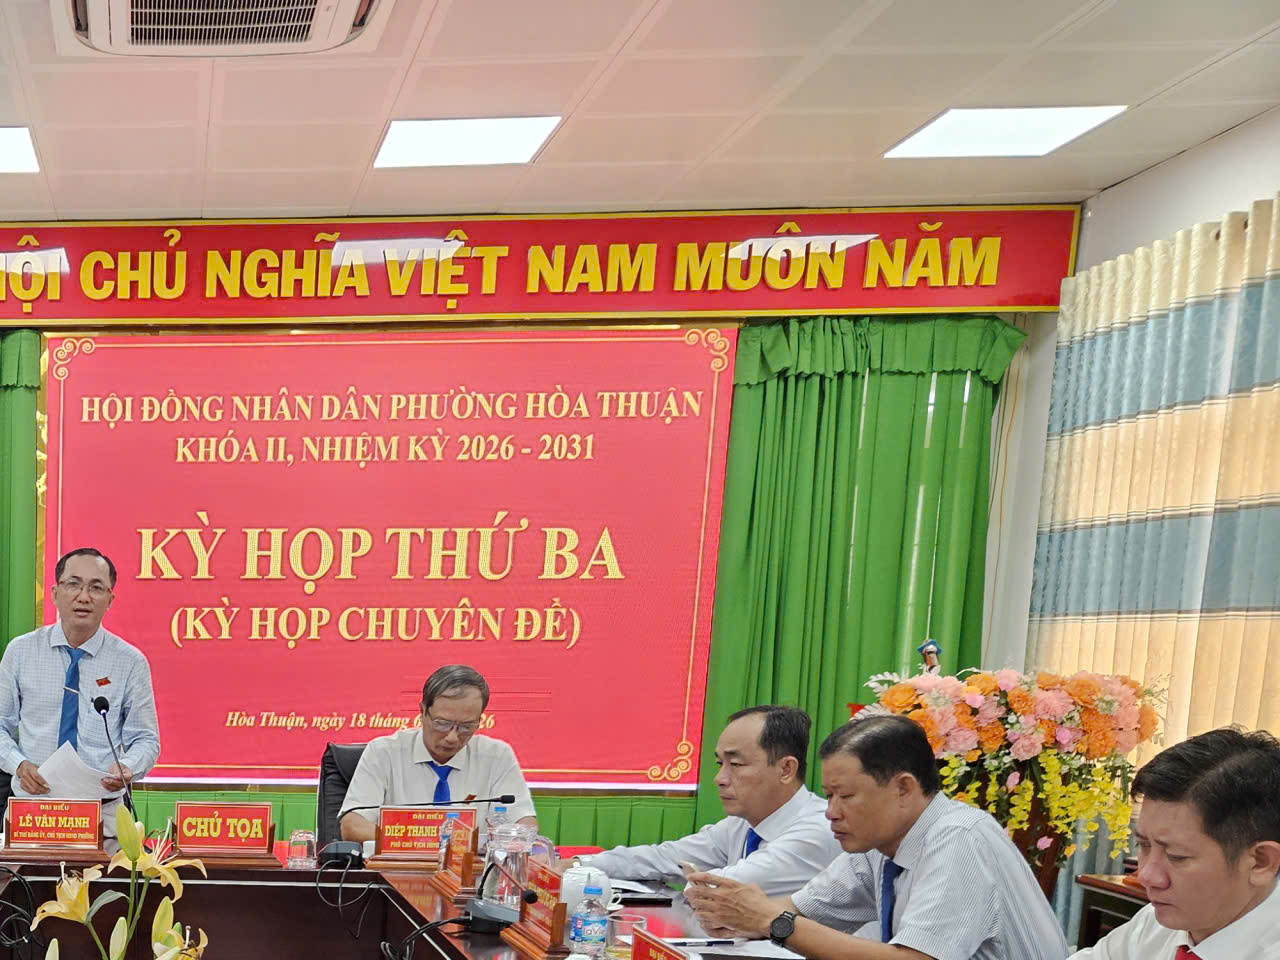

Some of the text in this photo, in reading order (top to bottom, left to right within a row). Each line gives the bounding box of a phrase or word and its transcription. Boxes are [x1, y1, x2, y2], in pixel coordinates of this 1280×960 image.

[80, 229, 187, 300] CHỦ
[205, 231, 371, 298] NGHĨA
[383, 229, 509, 309] VIỆT
[527, 243, 657, 293] NAM
[673, 222, 848, 291] MUÔN
[863, 222, 1001, 288] NĂM
[80, 384, 704, 429] HỘI ĐỒNG NHÂN DÂN PHƯỜNG HÒA THUẬN
[176, 429, 259, 462] KHÓA
[266, 436, 294, 467] II,
[301, 431, 400, 468] NHIỆM
[407, 428, 450, 461] KỲ
[456, 434, 515, 461] 2026
[538, 434, 595, 460] 2031
[135, 511, 625, 595] KỲ HỌP THỨ BA
[170, 597, 581, 649] (KỲ HỌP CHUYÊN ĐỀ)
[226, 711, 256, 728] Hòa
[260, 711, 308, 731] Thuận,
[311, 711, 346, 731] ngày
[349, 713, 367, 728] 18
[369, 711, 410, 731] tháng
[19, 813, 90, 831] LÊ VĂN MẠNH
[182, 811, 264, 843] CHỦ TỌA
[384, 823, 437, 839] DIỆP THANH
